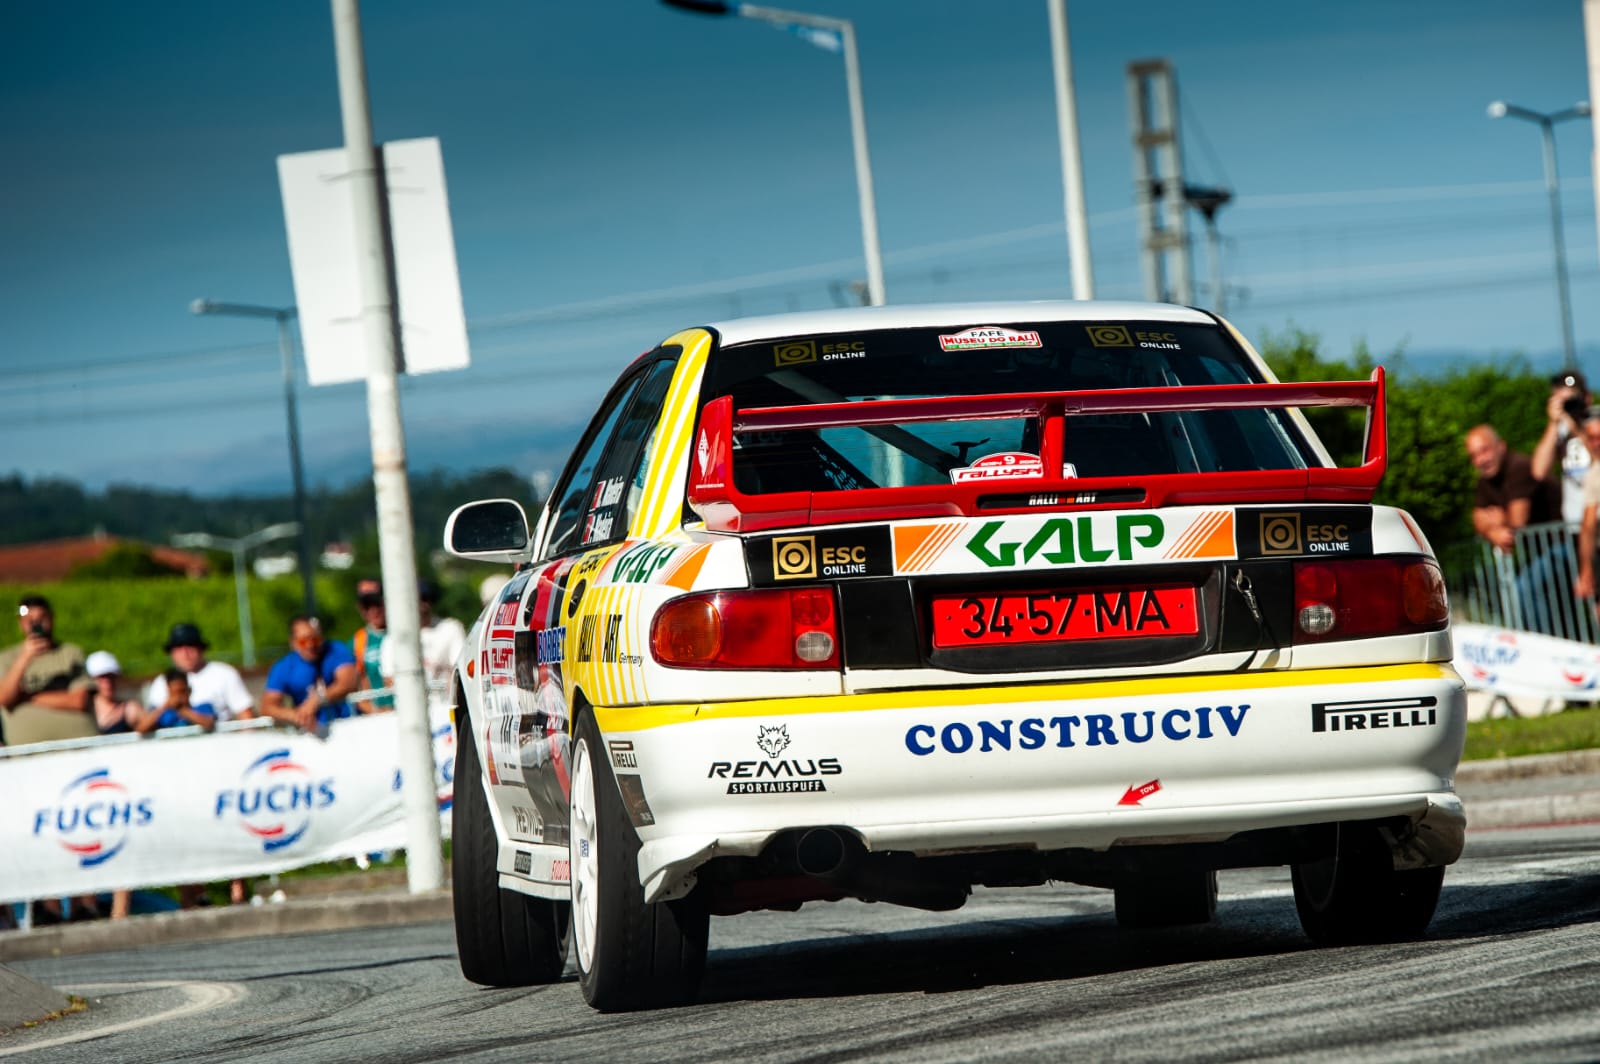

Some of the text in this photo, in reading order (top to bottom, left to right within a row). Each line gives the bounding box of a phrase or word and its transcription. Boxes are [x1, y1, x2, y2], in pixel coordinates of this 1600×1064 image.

[944, 336, 985, 346] MUSEU
[989, 336, 1006, 344] DO
[1008, 332, 1036, 343] RALI
[970, 330, 1005, 338] FAFE
[1135, 331, 1177, 342] ESC
[822, 341, 865, 354] ESC
[1140, 342, 1182, 351] ONLINE
[823, 351, 866, 361] ONLINE
[1003, 455, 1016, 465] 9
[1028, 491, 1098, 506] RALLI ART
[966, 513, 1165, 567] GALP
[1306, 525, 1349, 542] ESC
[1309, 542, 1350, 552] ONLINE
[822, 546, 866, 565] ESC
[823, 563, 867, 576] ONLINE
[537, 627, 567, 665] BORBET
[602, 613, 623, 664] ART
[618, 652, 644, 667] Germany
[1311, 695, 1438, 733] PIRELLI
[905, 704, 1251, 756] CONSTRUCIV
[708, 757, 843, 779] REMUS
[732, 780, 821, 794] SPORTAUSPUFF
[33, 777, 337, 836] FUCHS FUCHS
